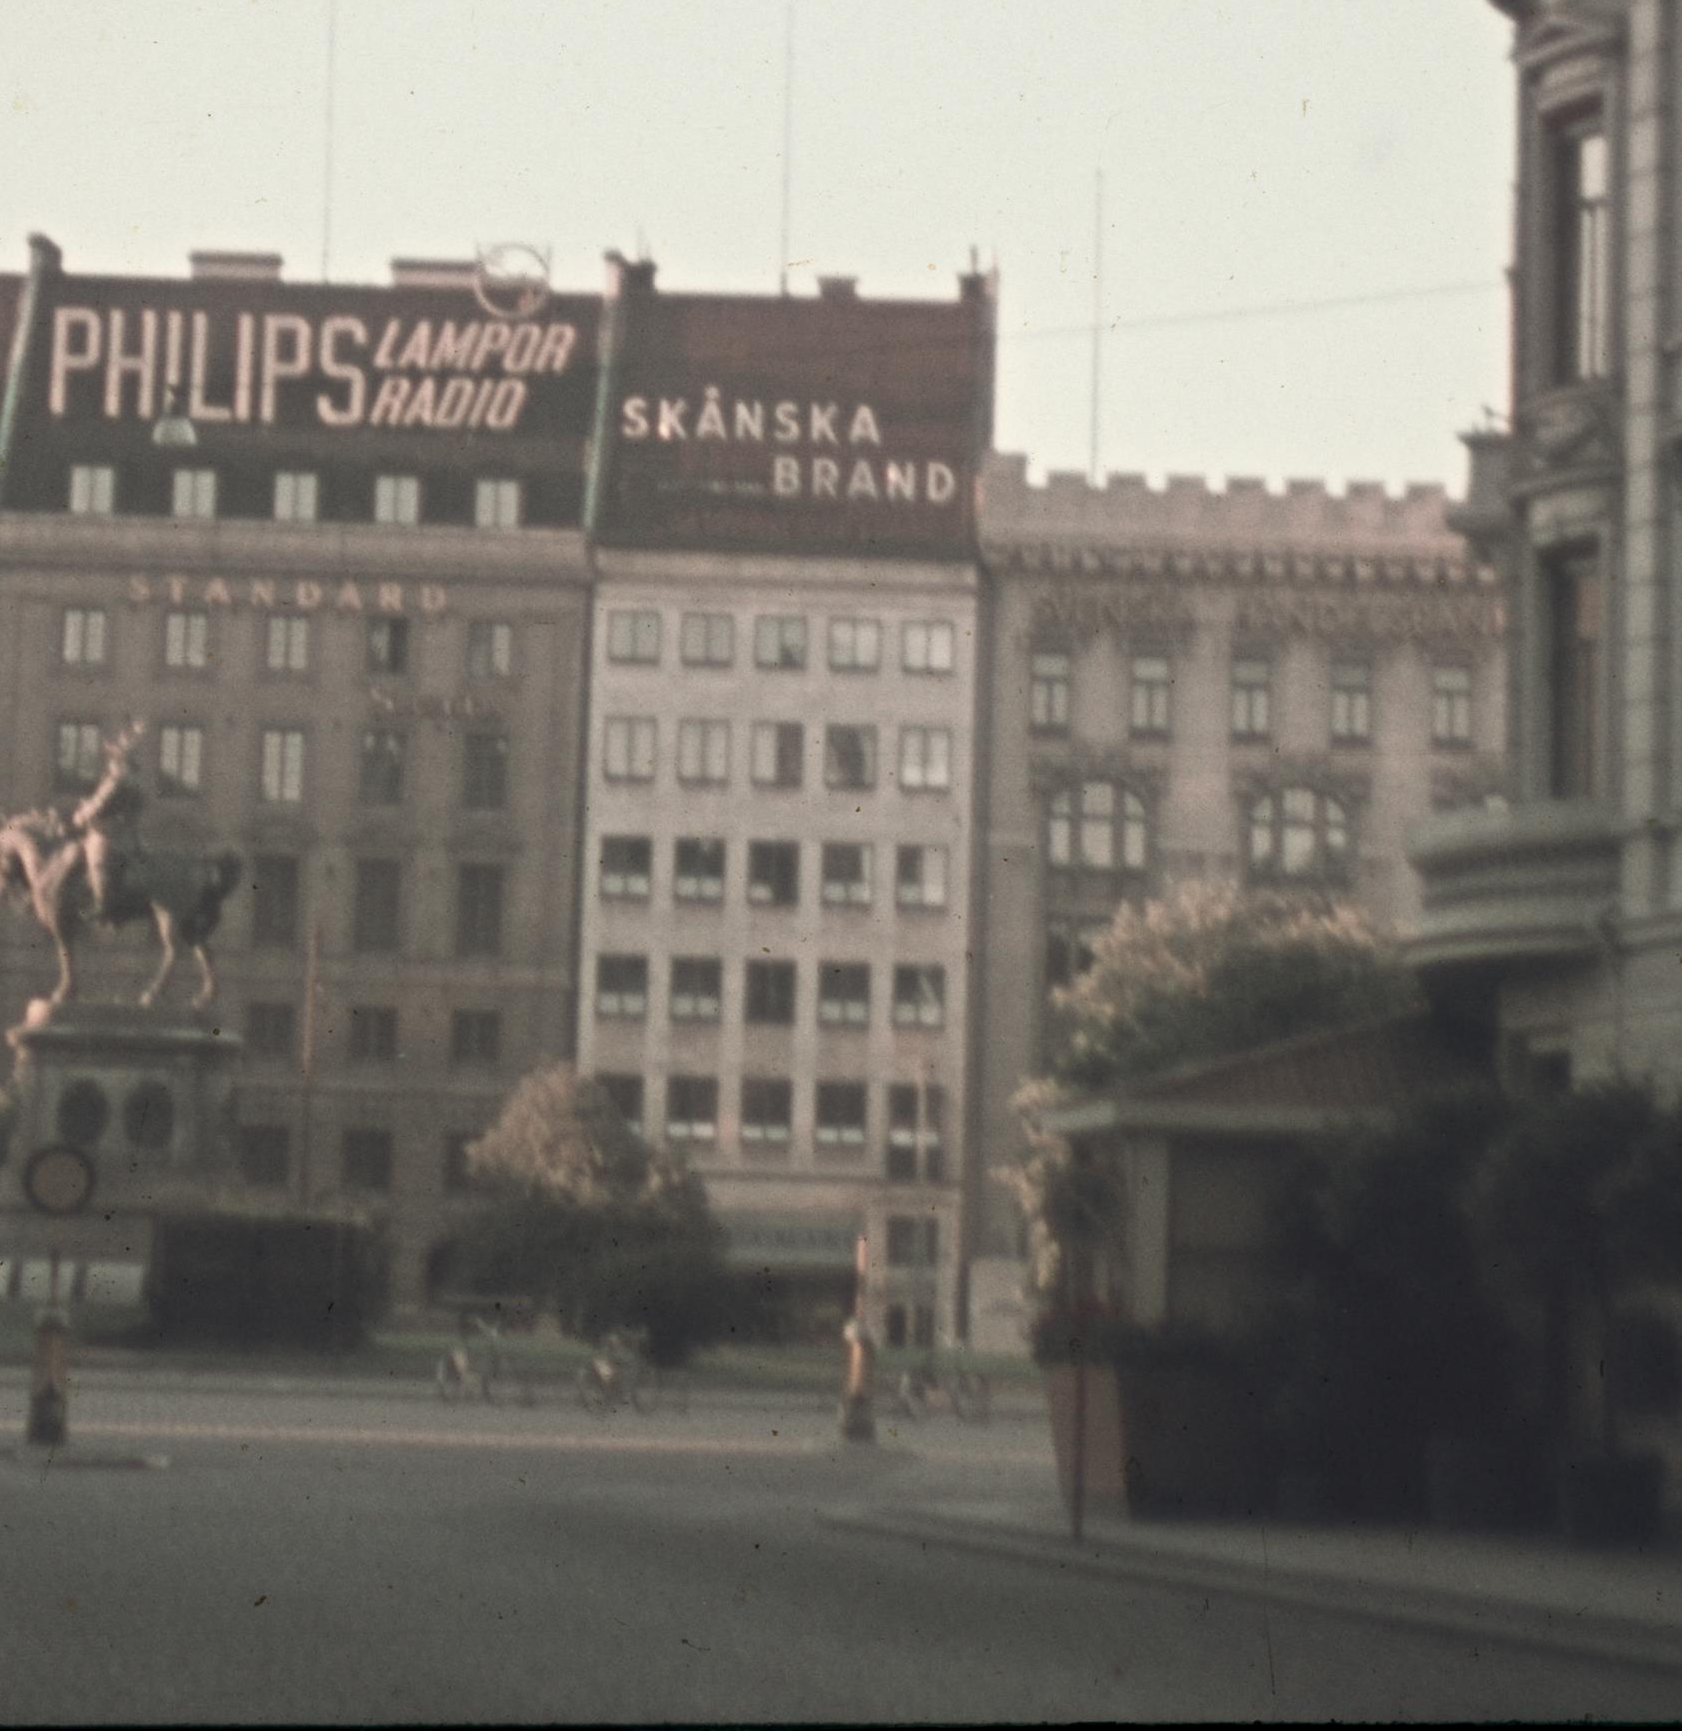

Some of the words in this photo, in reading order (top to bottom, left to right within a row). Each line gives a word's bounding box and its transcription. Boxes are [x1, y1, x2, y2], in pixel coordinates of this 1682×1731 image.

[48, 305, 368, 426] PHILIPS
[373, 316, 577, 375] LAMPOR
[370, 375, 528, 429] RADIO
[621, 385, 883, 447] SKÅNSKA
[771, 453, 959, 504] BRAND
[125, 577, 449, 613] STANDARD
